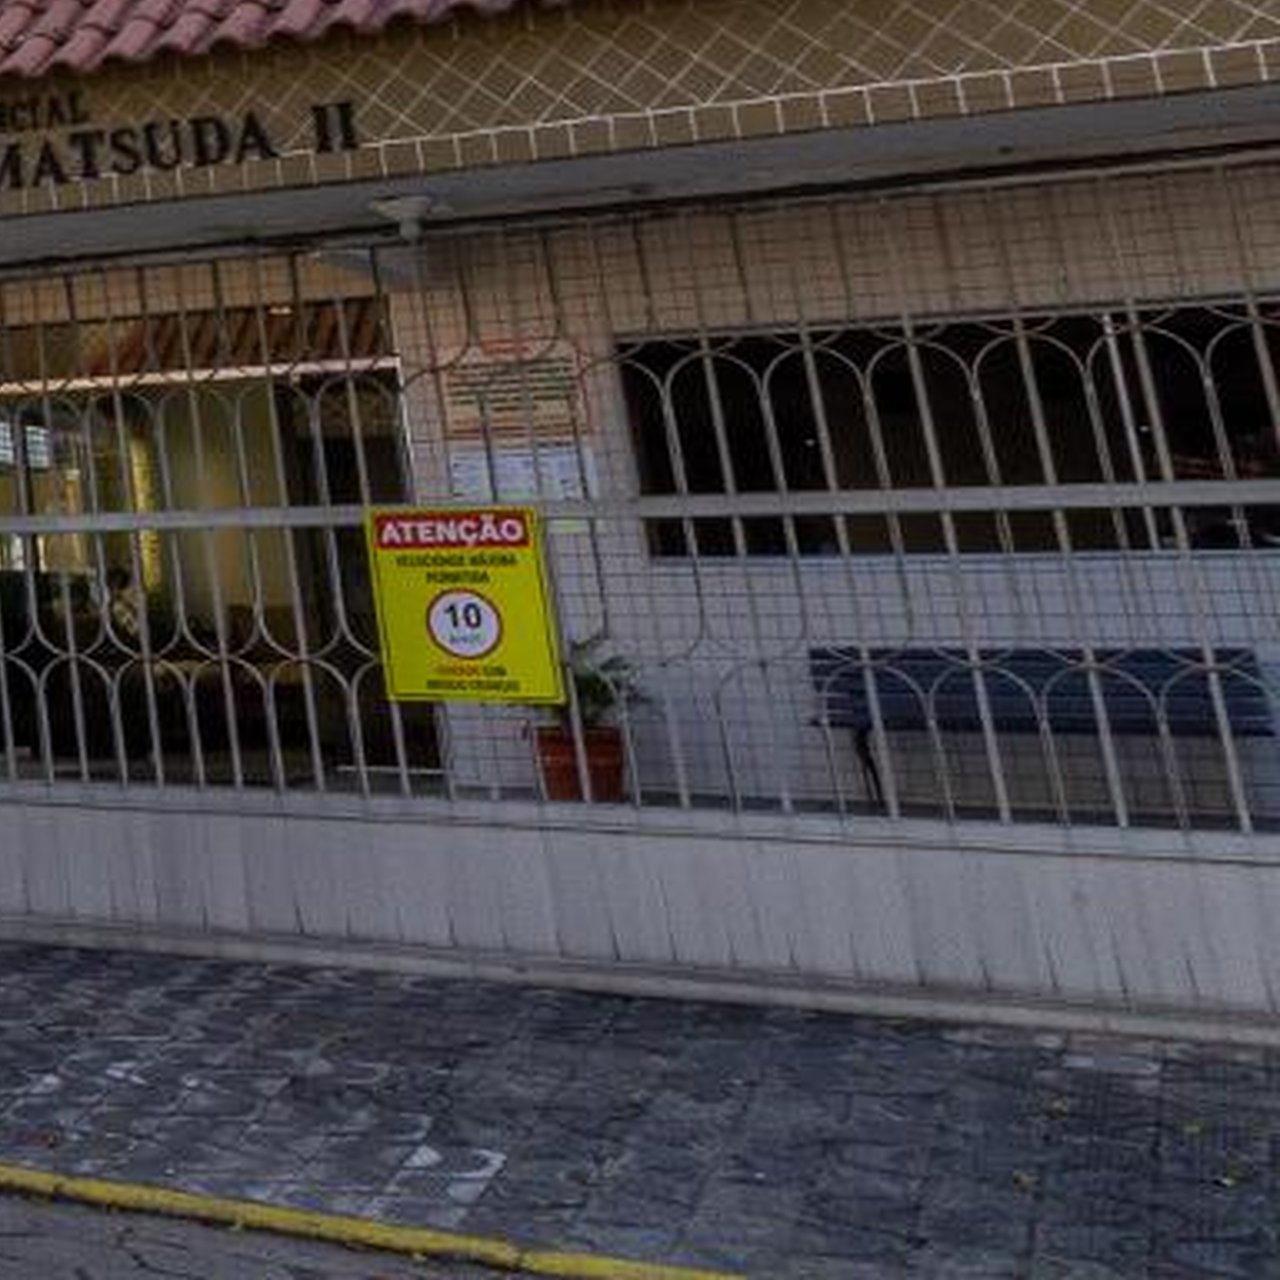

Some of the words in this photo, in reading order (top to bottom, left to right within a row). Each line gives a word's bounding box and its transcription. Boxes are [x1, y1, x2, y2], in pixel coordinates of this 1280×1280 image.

[311, 102, 359, 153] II
[382, 514, 524, 548] ATENÇÃO
[444, 603, 482, 629] 10
